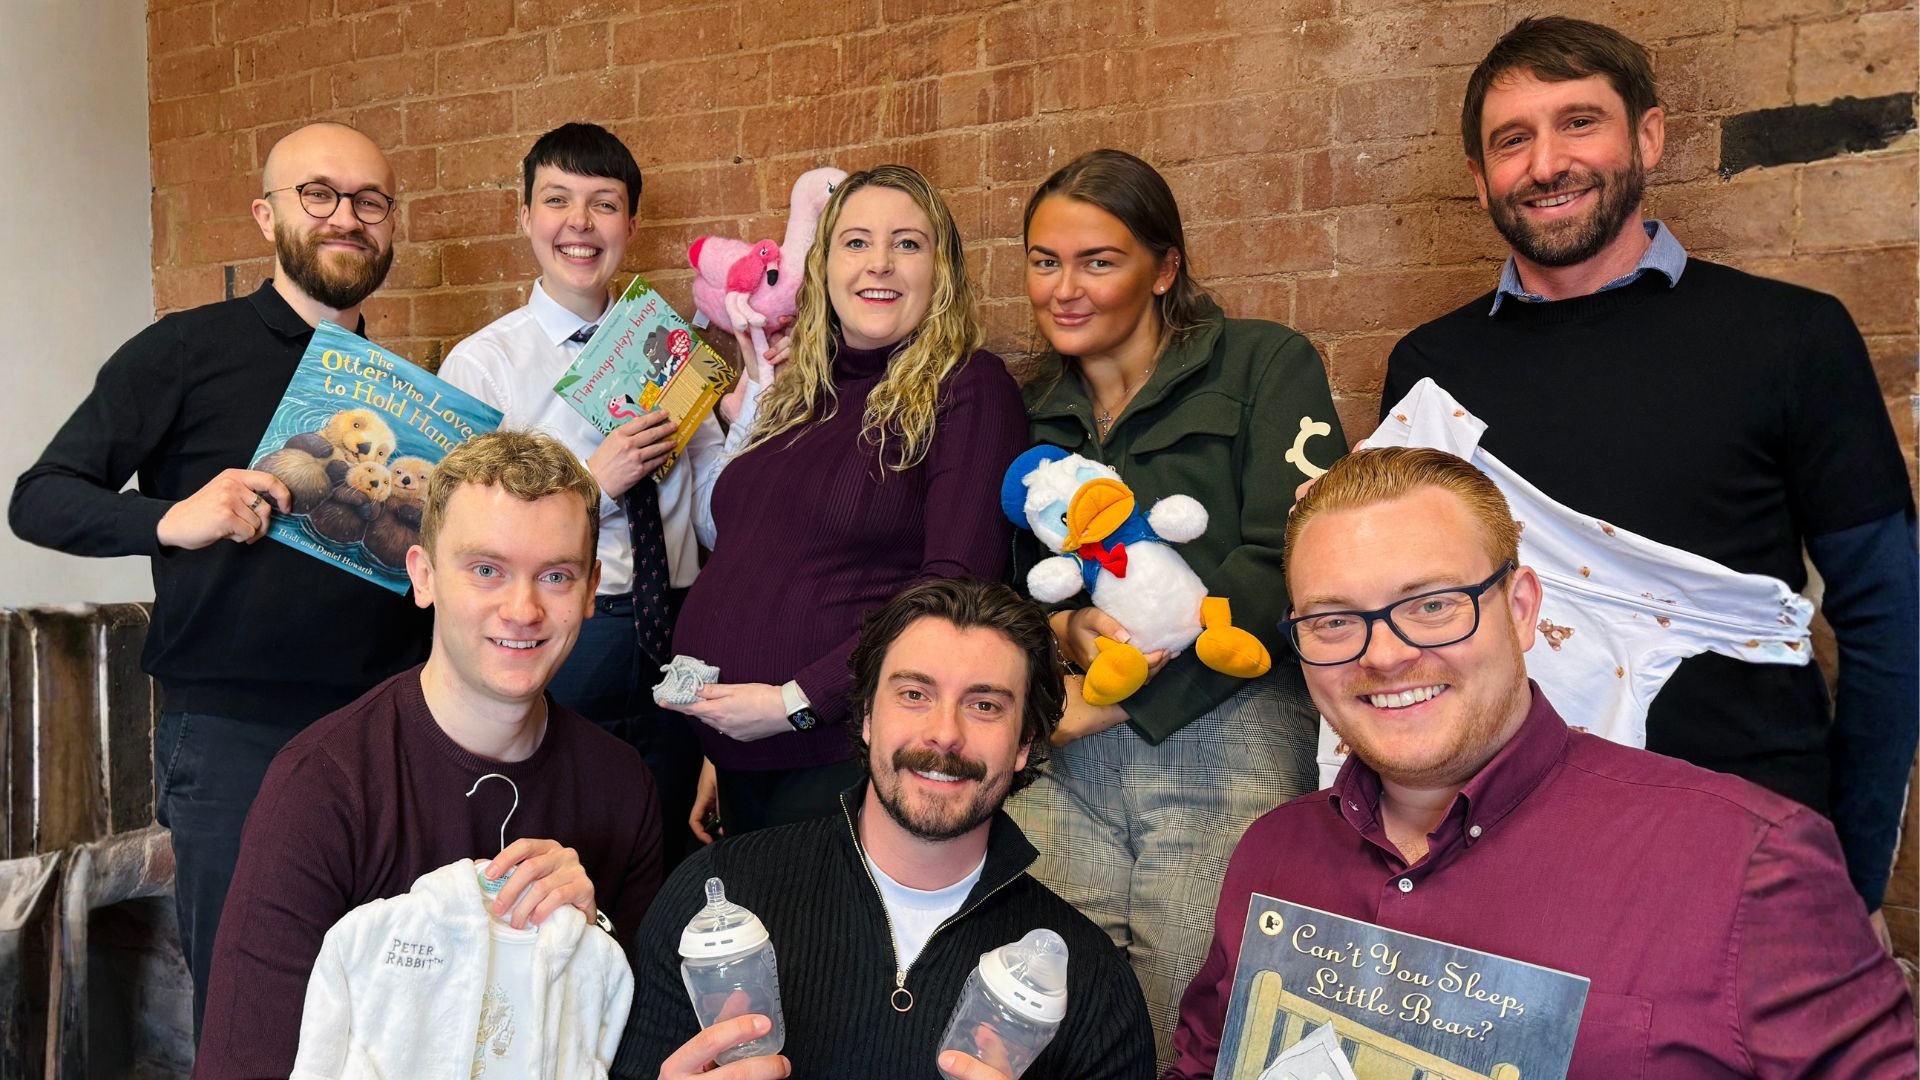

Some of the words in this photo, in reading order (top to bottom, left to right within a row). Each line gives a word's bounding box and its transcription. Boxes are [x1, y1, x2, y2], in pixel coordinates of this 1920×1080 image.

[322, 350, 387, 382] Otter
[366, 349, 394, 371] The
[572, 355, 615, 404] Flamingo
[614, 327, 635, 360] plays
[629, 298, 658, 327] bingo
[324, 375, 347, 396] to
[352, 380, 407, 418] Hold
[408, 408, 464, 454] Hand
[277, 528, 300, 544] Heidi
[300, 539, 317, 551] and
[316, 545, 341, 562] Daniel
[341, 554, 373, 576] Howarth
[392, 938, 434, 956] PETER
[1291, 923, 1365, 969] Can't
[1370, 943, 1434, 987] You
[1438, 962, 1526, 1018] Sleep,
[1307, 967, 1396, 1015] Little
[1399, 992, 1494, 1042] Bear?
